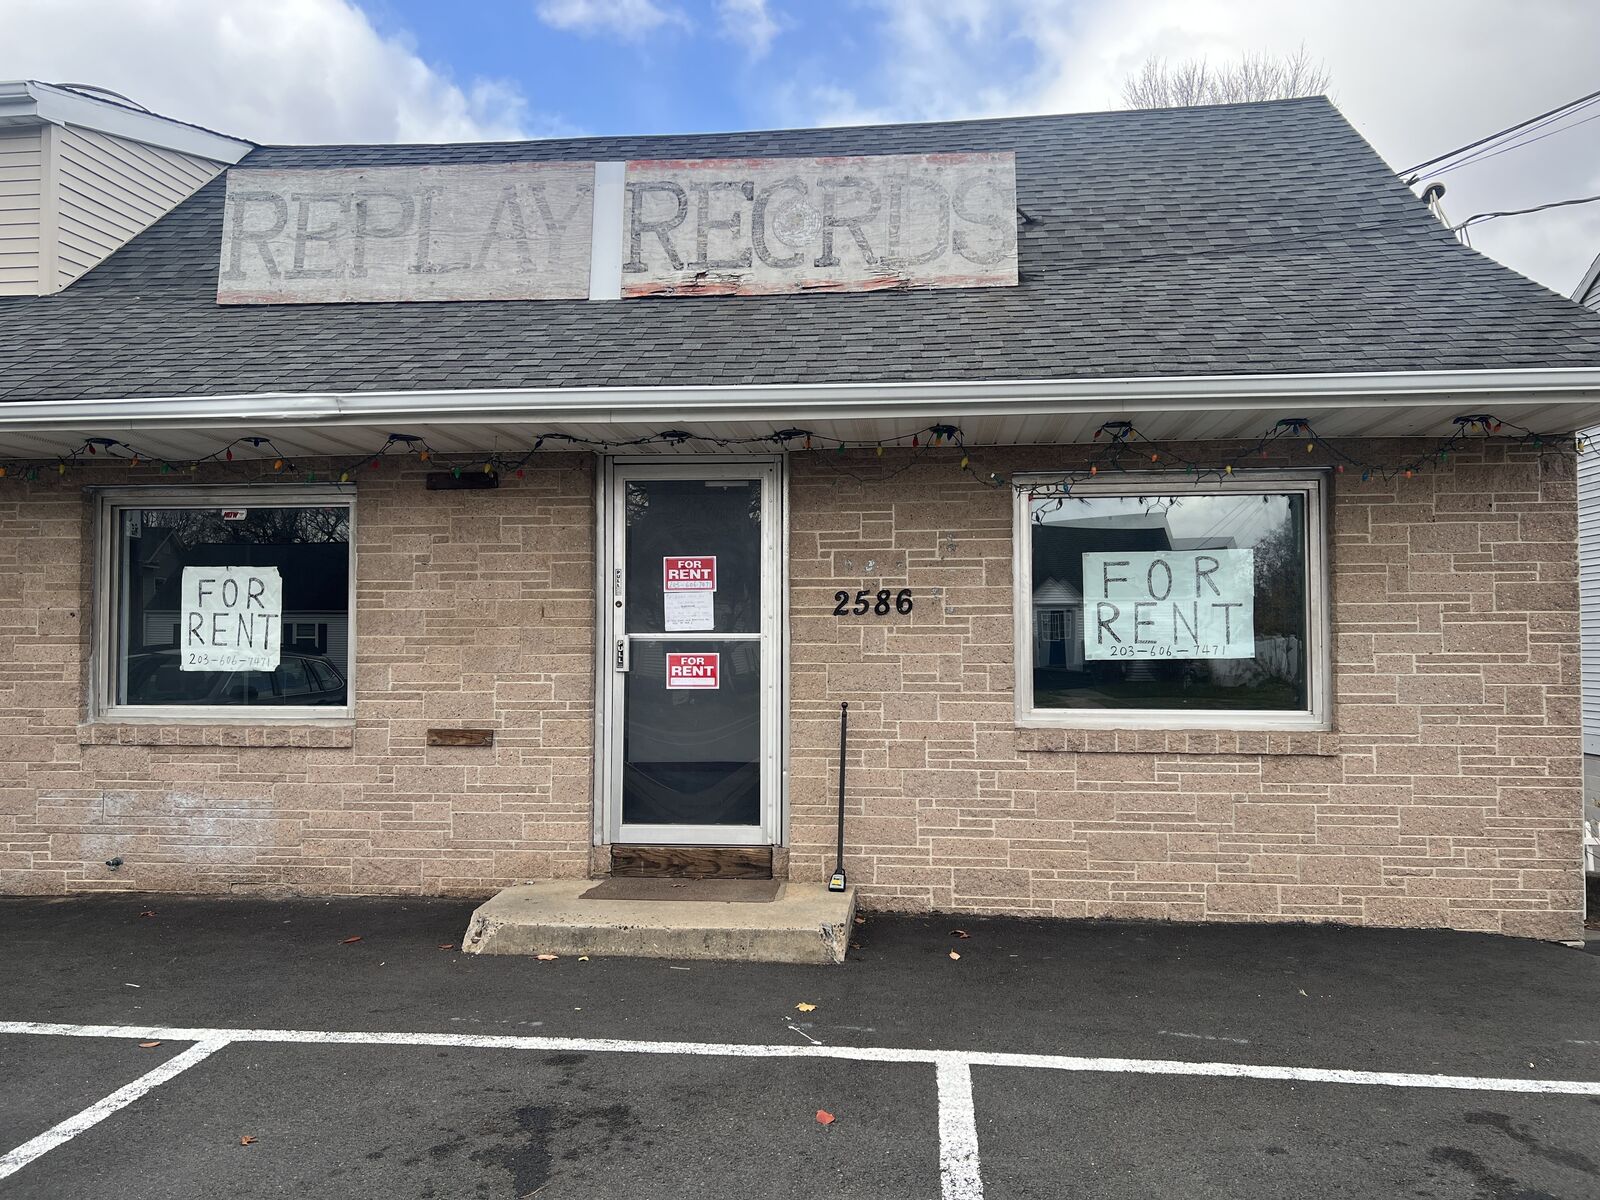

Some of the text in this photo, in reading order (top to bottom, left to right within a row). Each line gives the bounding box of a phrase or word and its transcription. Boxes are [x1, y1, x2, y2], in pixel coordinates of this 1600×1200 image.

[221, 183, 593, 281] REPLAY
[668, 569, 711, 580] RENT
[678, 561, 702, 569] FOR
[1103, 556, 1221, 602] FOR
[198, 577, 266, 609] FOR
[833, 588, 913, 616] 2586
[188, 611, 279, 650] RENT
[1096, 601, 1243, 645] RENT
[189, 653, 271, 667] 203-606-7471
[681, 657, 705, 665] FOR
[1110, 644, 1226, 657] 203-606-7471
[671, 666, 715, 676] RENT
